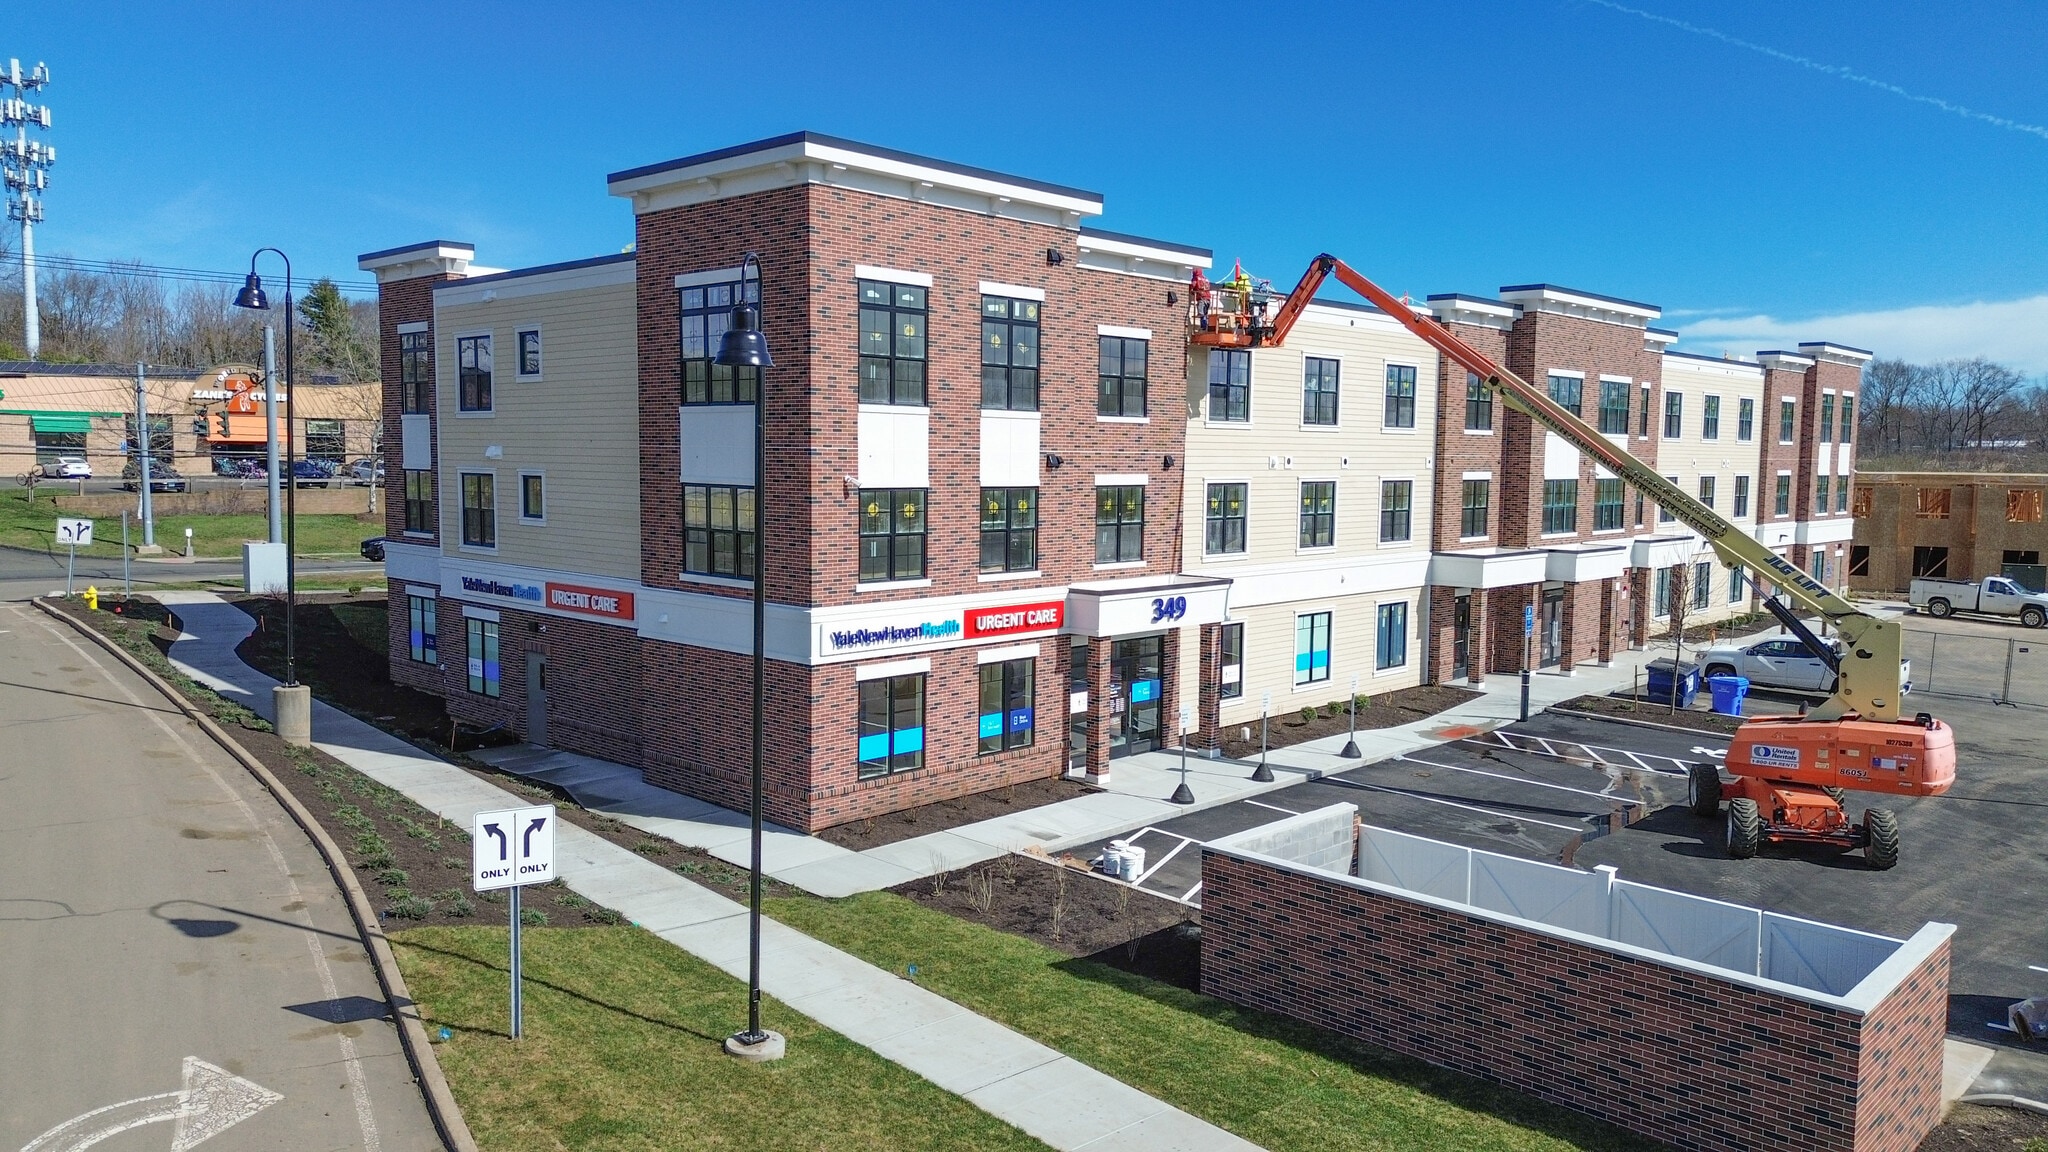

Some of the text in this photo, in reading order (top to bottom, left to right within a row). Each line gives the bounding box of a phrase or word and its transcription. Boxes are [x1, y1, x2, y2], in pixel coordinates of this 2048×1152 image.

[250, 392, 288, 402] CYCES
[1763, 556, 1831, 599] JLG LIFT
[551, 589, 619, 613] URGENT CARE
[1151, 596, 1187, 622] 349
[977, 608, 1058, 631] URGENT CARE
[1771, 747, 1796, 755] United
[1771, 753, 1797, 761] Rentals
[1839, 768, 1868, 777] 860SJ
[481, 868, 510, 879] ONLY
[520, 863, 548, 874] ONLY
